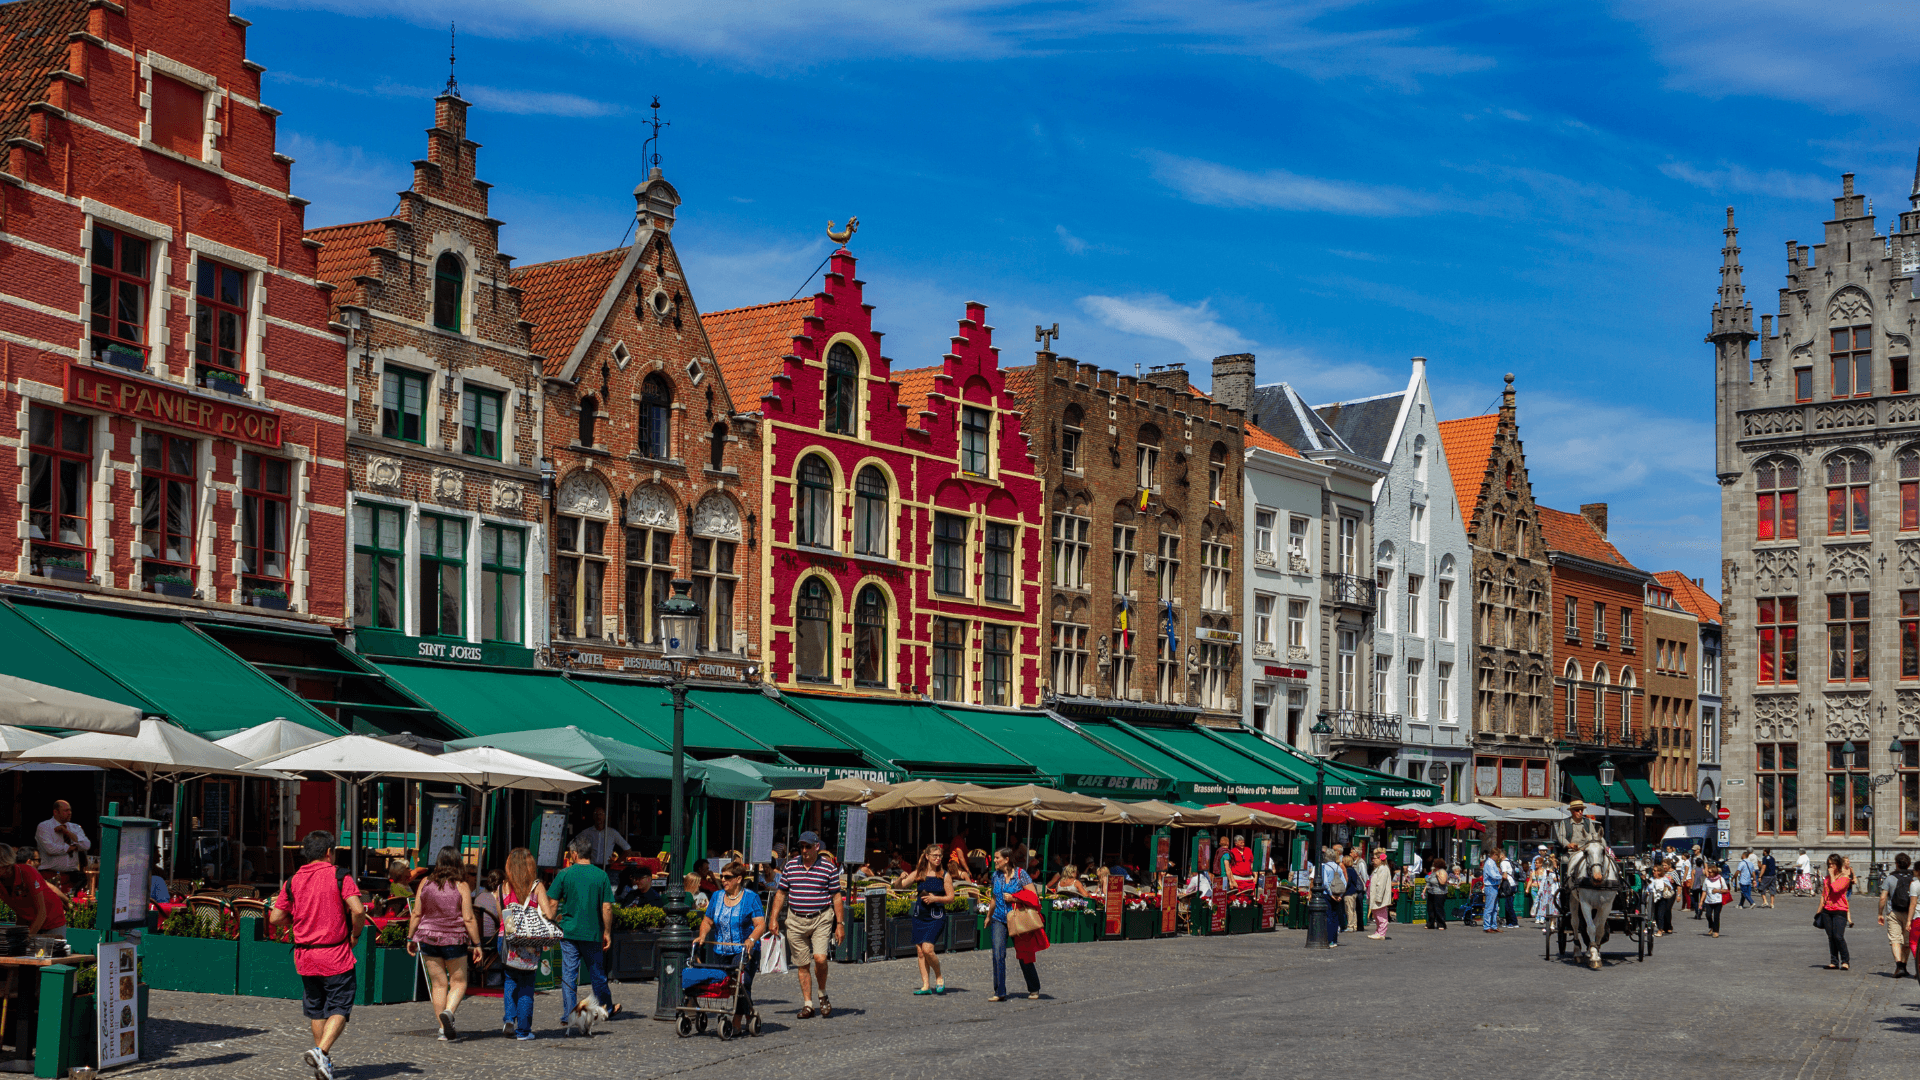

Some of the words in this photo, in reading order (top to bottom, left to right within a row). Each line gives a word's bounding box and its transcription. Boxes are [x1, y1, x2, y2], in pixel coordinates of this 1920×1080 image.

[78, 377, 112, 406] LE
[118, 382, 215, 429] PANIER
[221, 410, 276, 442] D'OR
[418, 642, 446, 657] SINT
[449, 645, 482, 660] JORIS
[698, 663, 737, 677] CENTRAL
[1058, 704, 1119, 716] RESTAURANT
[1121, 707, 1134, 717] LA
[1077, 775, 1106, 787] CAFE
[1108, 776, 1129, 788] DES
[1131, 778, 1159, 790] ARTS
[1194, 783, 1222, 793] Brasserie
[1227, 785, 1235, 794] La
[1272, 785, 1299, 795] Restaurant
[1325, 786, 1341, 796] PETIT
[1380, 787, 1410, 797] Friterie
[1411, 789, 1432, 798] 1900
